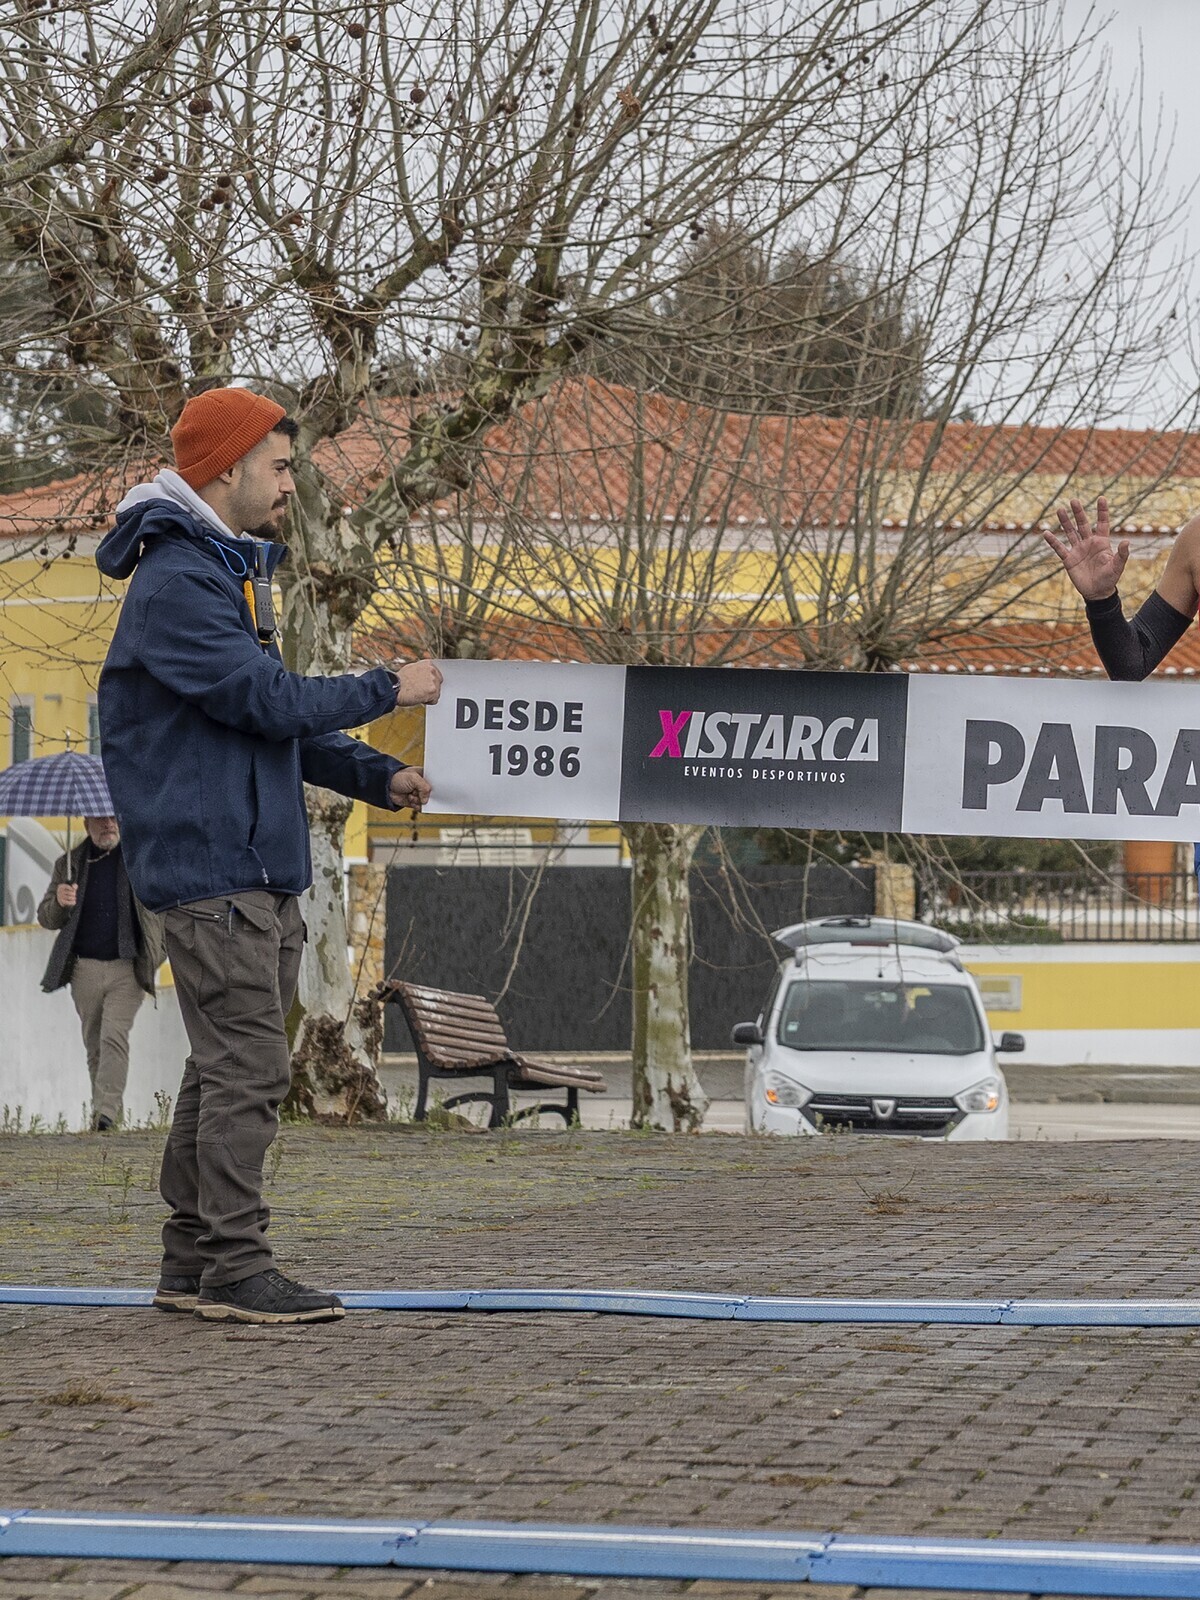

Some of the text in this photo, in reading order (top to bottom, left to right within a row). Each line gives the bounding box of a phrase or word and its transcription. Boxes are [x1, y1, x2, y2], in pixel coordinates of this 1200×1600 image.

[455, 697, 584, 733] DESDE
[649, 709, 880, 762] XISTARCA
[488, 744, 581, 778] 1986
[684, 765, 846, 784] EVENTOS DESPORTIVOS
